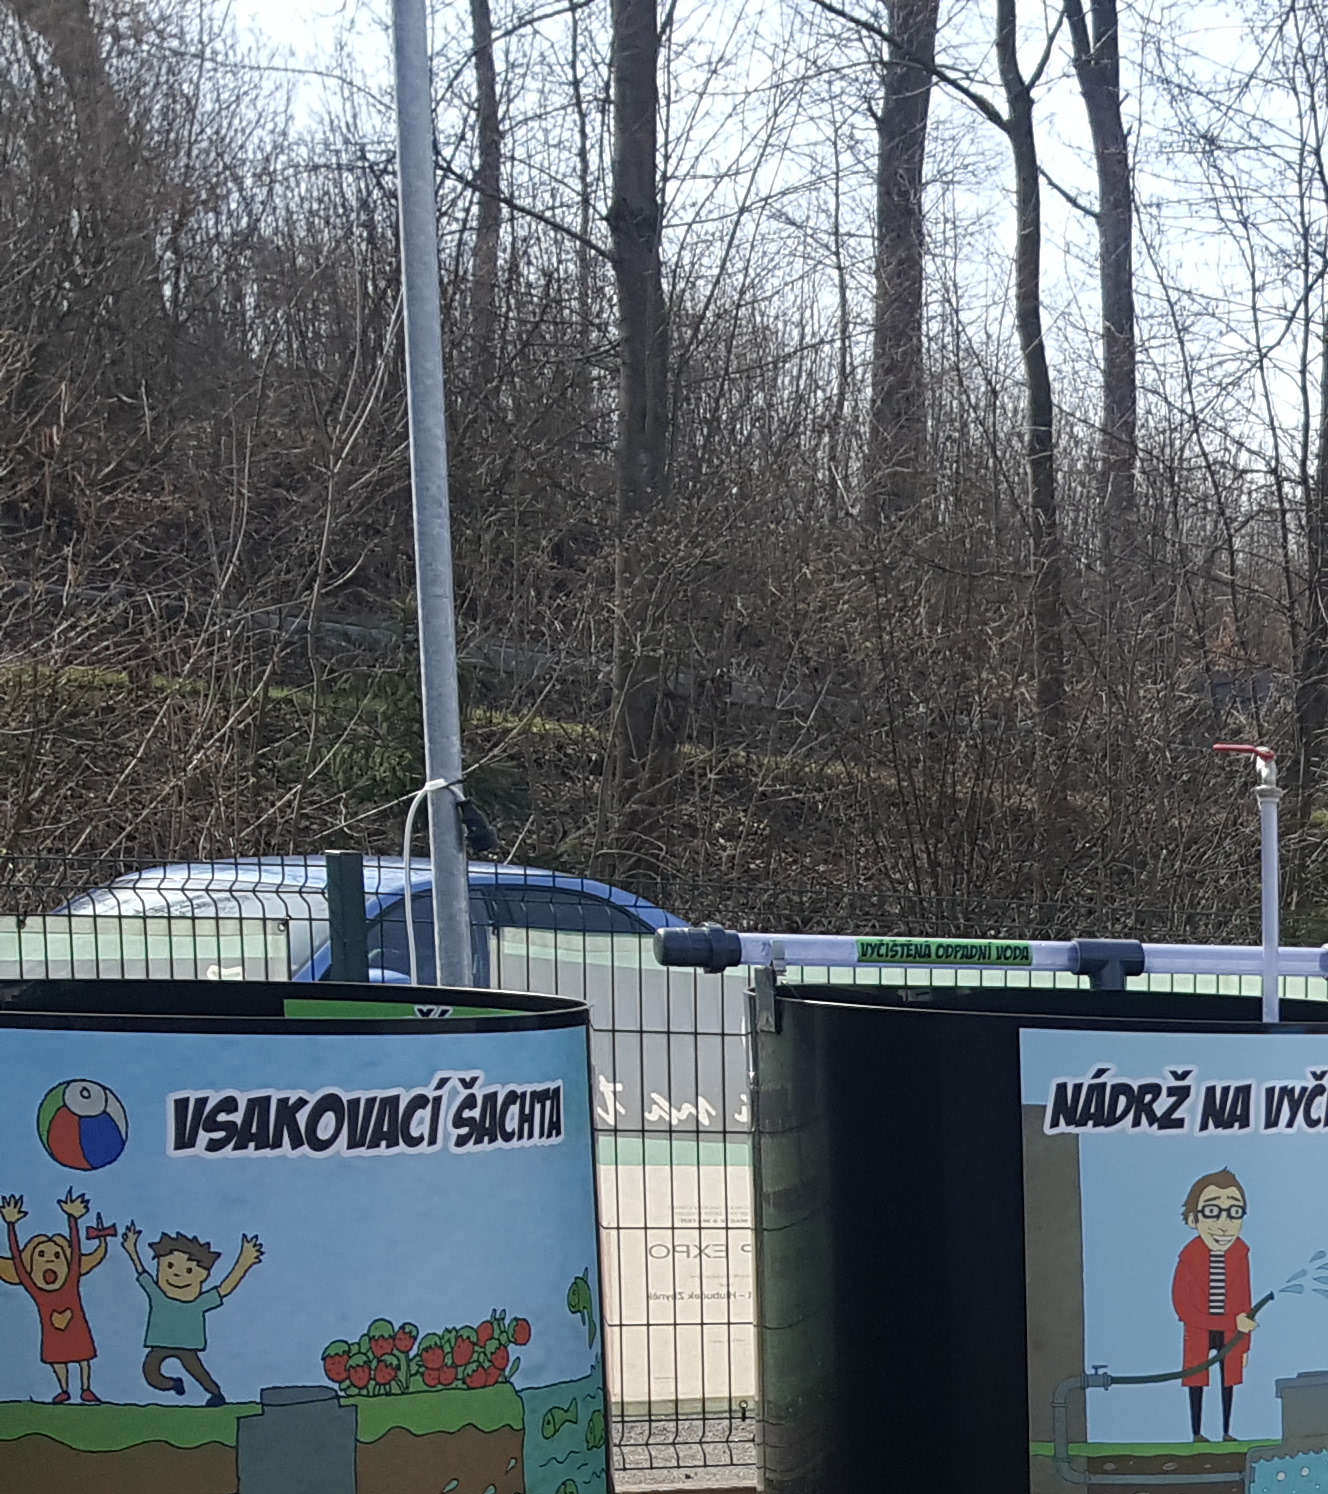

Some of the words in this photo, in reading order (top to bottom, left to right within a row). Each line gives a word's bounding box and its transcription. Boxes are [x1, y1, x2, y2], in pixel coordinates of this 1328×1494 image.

[860, 939, 932, 960] VYČIŠTĚNÁ
[935, 942, 992, 961] ODPADNÍ
[995, 946, 1030, 961] VODA
[172, 1076, 453, 1153] VSAKOVACÍ
[450, 1076, 562, 1149] ŠACHTA
[1049, 1067, 1194, 1131] NÁDRŽ
[1199, 1084, 1254, 1133] NA
